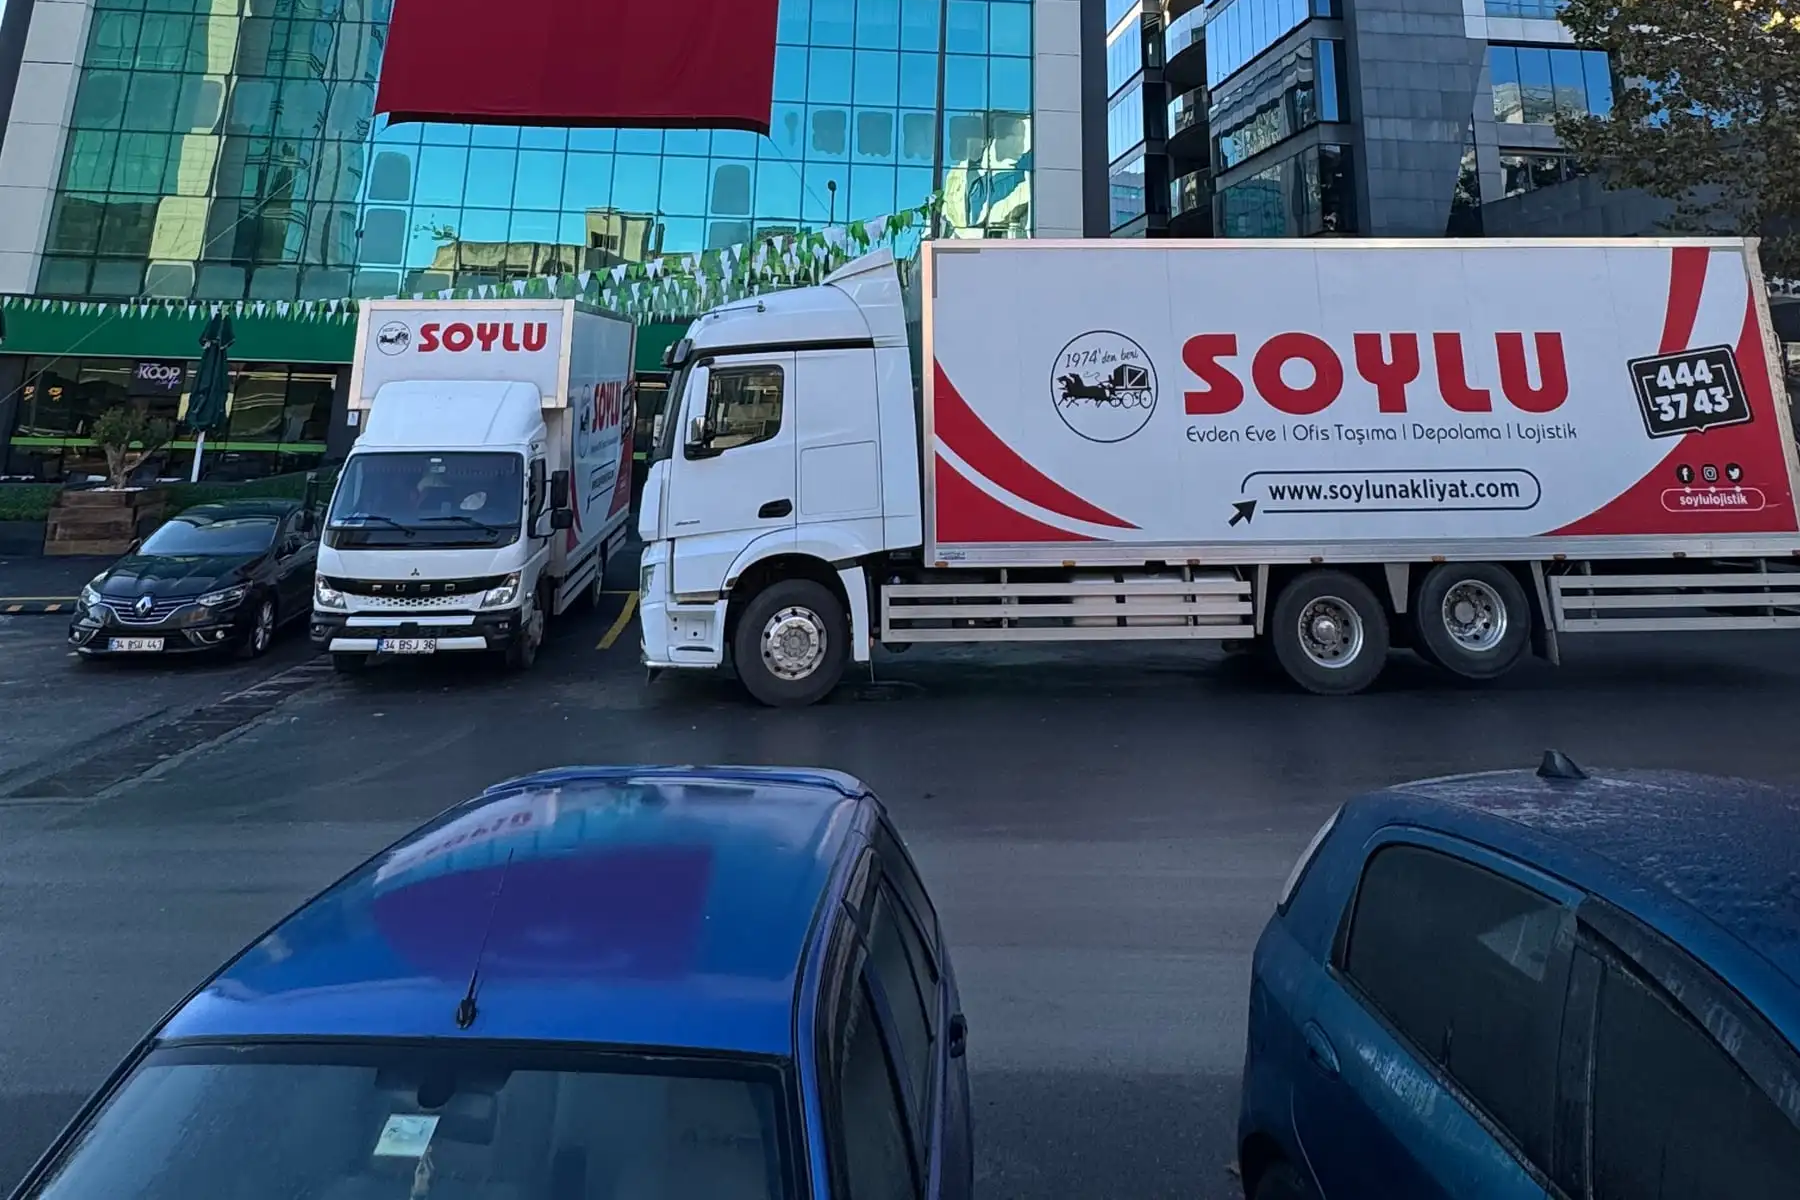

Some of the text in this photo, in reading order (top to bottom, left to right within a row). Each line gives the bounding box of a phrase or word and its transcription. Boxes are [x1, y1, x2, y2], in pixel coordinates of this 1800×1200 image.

[418, 322, 548, 352] SOYLU
[137, 365, 181, 380] KOOP
[1182, 332, 1569, 415] SOYLU
[1656, 359, 1714, 390] 444
[1655, 386, 1730, 422] 37 43
[1186, 423, 1577, 445] Evden Eve Ofis Taşıma Depolama Lojistik
[1268, 479, 1520, 502] www.soylunakliyat.com
[1679, 492, 1749, 507] soylulojistik
[372, 584, 455, 592] FUSO
[384, 640, 395, 650] 34
